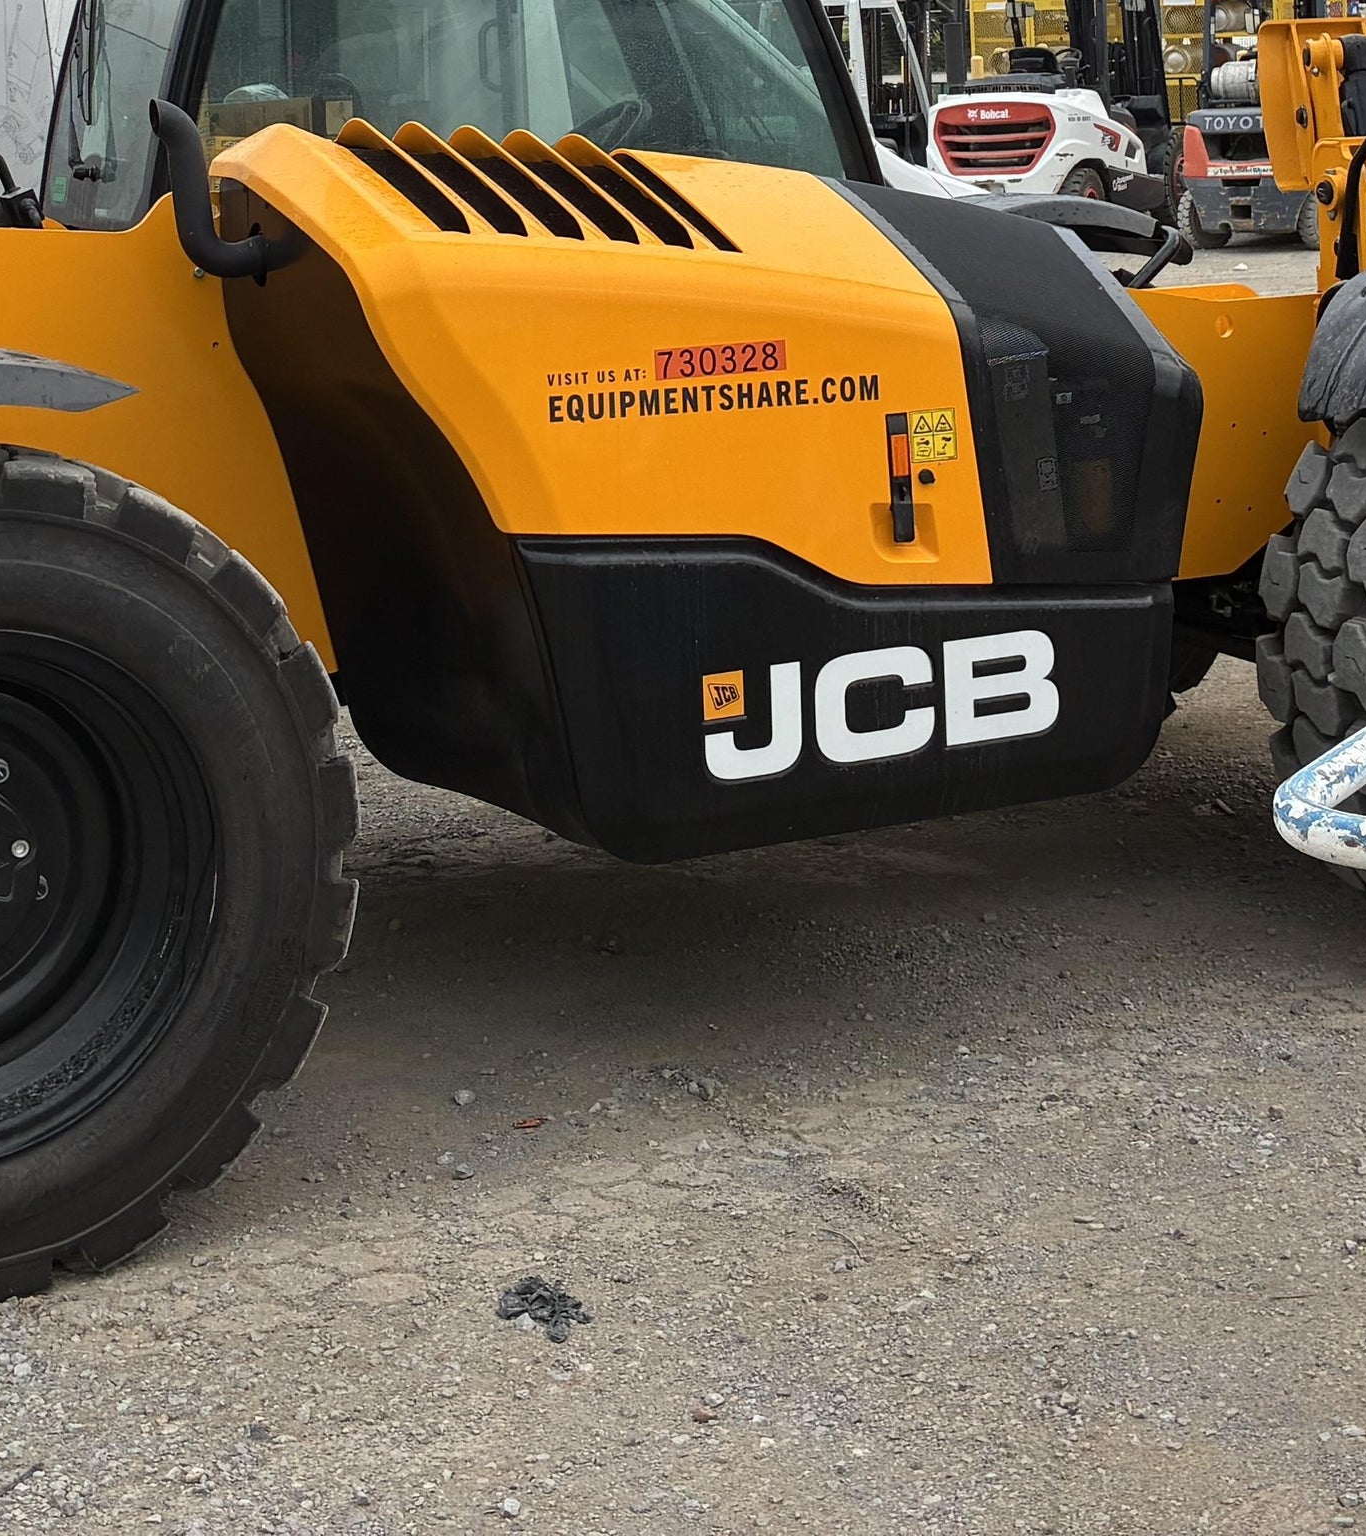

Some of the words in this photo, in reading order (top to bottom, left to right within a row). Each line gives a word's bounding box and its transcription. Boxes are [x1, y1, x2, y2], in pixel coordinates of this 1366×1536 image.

[980, 108, 1009, 120] Bobcat
[657, 342, 779, 379] 730328
[547, 371, 589, 387] VISIT
[597, 369, 617, 383] US
[624, 367, 648, 382] AT:
[549, 374, 880, 423] EQUIPMENTSHARE.COM
[704, 629, 1060, 781] JCB
[710, 684, 739, 709] JCB
